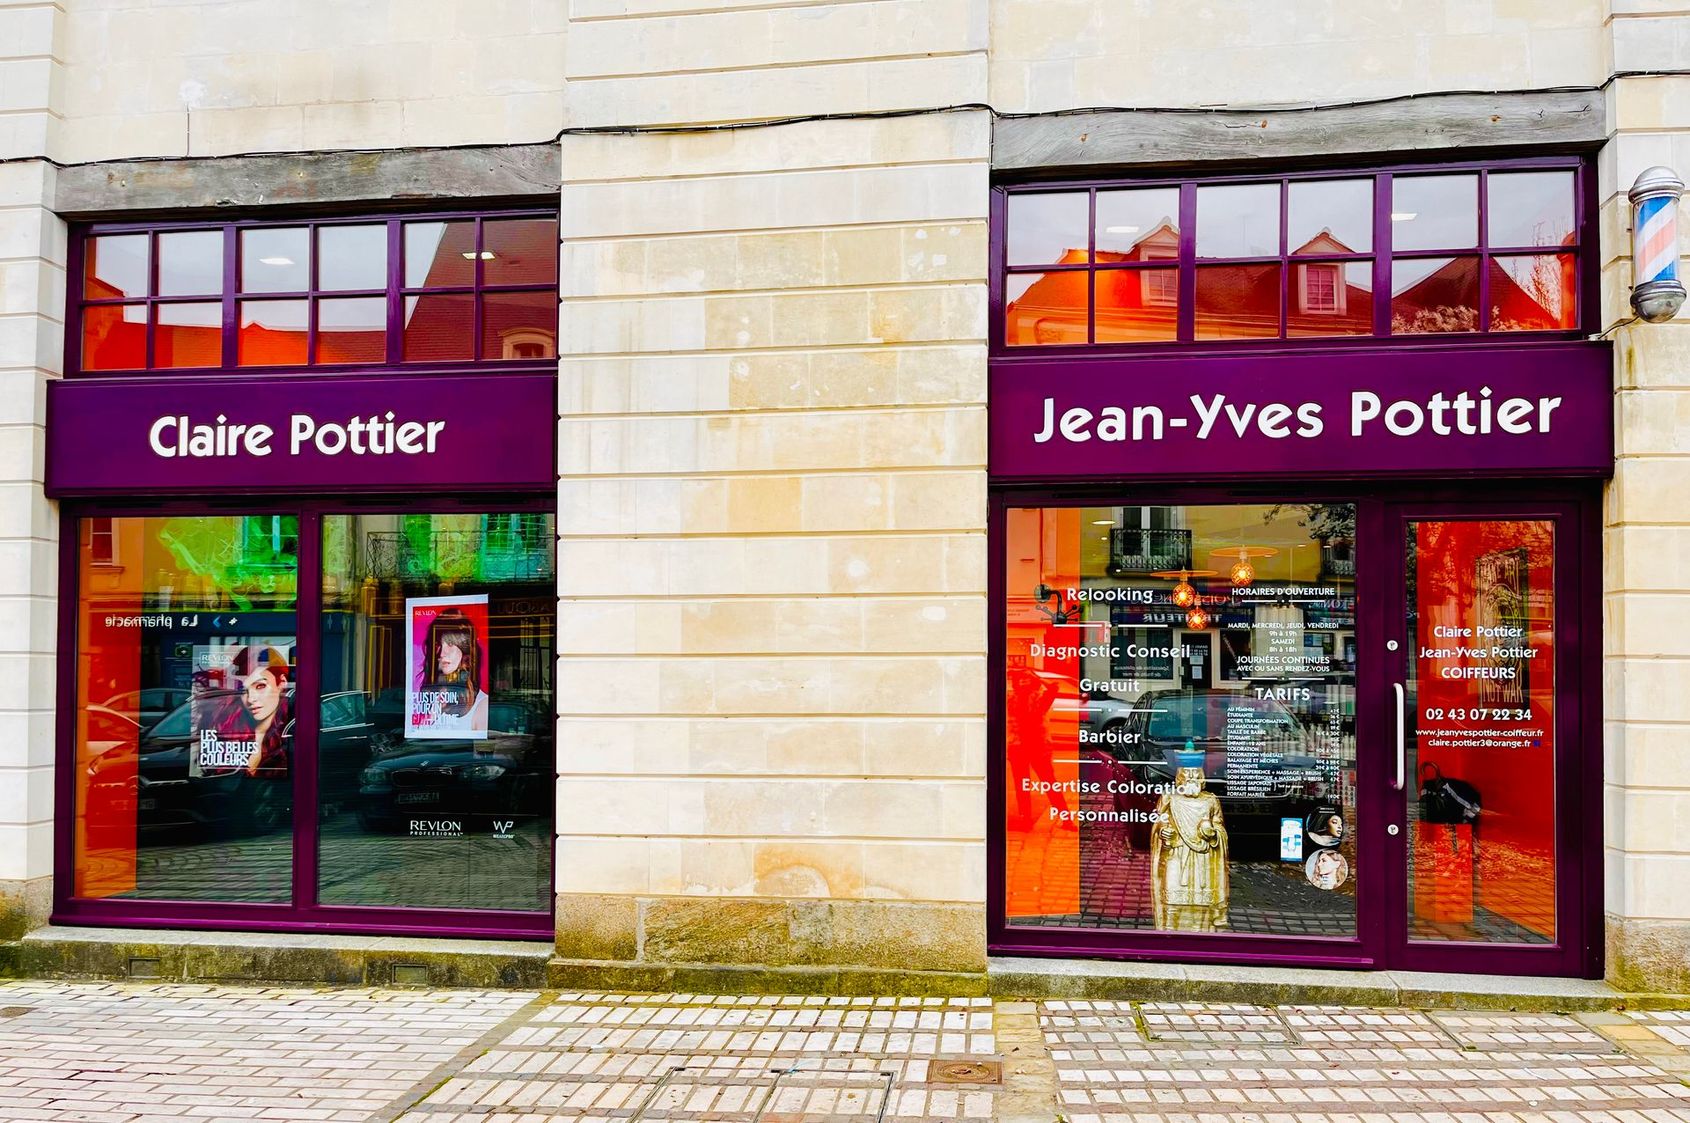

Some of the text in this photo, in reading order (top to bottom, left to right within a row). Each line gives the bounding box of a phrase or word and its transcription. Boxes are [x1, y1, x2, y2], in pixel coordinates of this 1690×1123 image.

[1033, 386, 1562, 443] Jean-Yves Pottier
[149, 411, 445, 458] Claire Pottier
[1067, 587, 1153, 604] Relooking
[1231, 587, 1335, 596] HORAIRES D'OUVERTURE
[1434, 626, 1523, 638] Claire Pottier
[1030, 644, 1120, 660] Diagnostic
[1126, 644, 1191, 659] Conseil
[1419, 646, 1538, 659] Jean-Yves Pottier
[1236, 655, 1330, 664] JOURNÉES CONTINUES
[1441, 667, 1516, 679] COIFFEURS
[1079, 678, 1140, 693] Gratuit
[1255, 687, 1310, 700] TARIFS
[1425, 708, 1532, 721] 02 43 07 22 34
[200, 729, 218, 741] LES
[1079, 729, 1141, 744] Barbier
[1415, 728, 1544, 739] www.jeanyvespottier-coiffeur.fr
[200, 741, 258, 754] PLUS BELLES
[1428, 739, 1531, 749] claire.pottier3@orange.fr
[200, 753, 249, 766] COULEURS
[1022, 778, 1101, 794] Expertise
[1049, 806, 1169, 824] Personnalisée
[410, 820, 462, 832] REVLON
